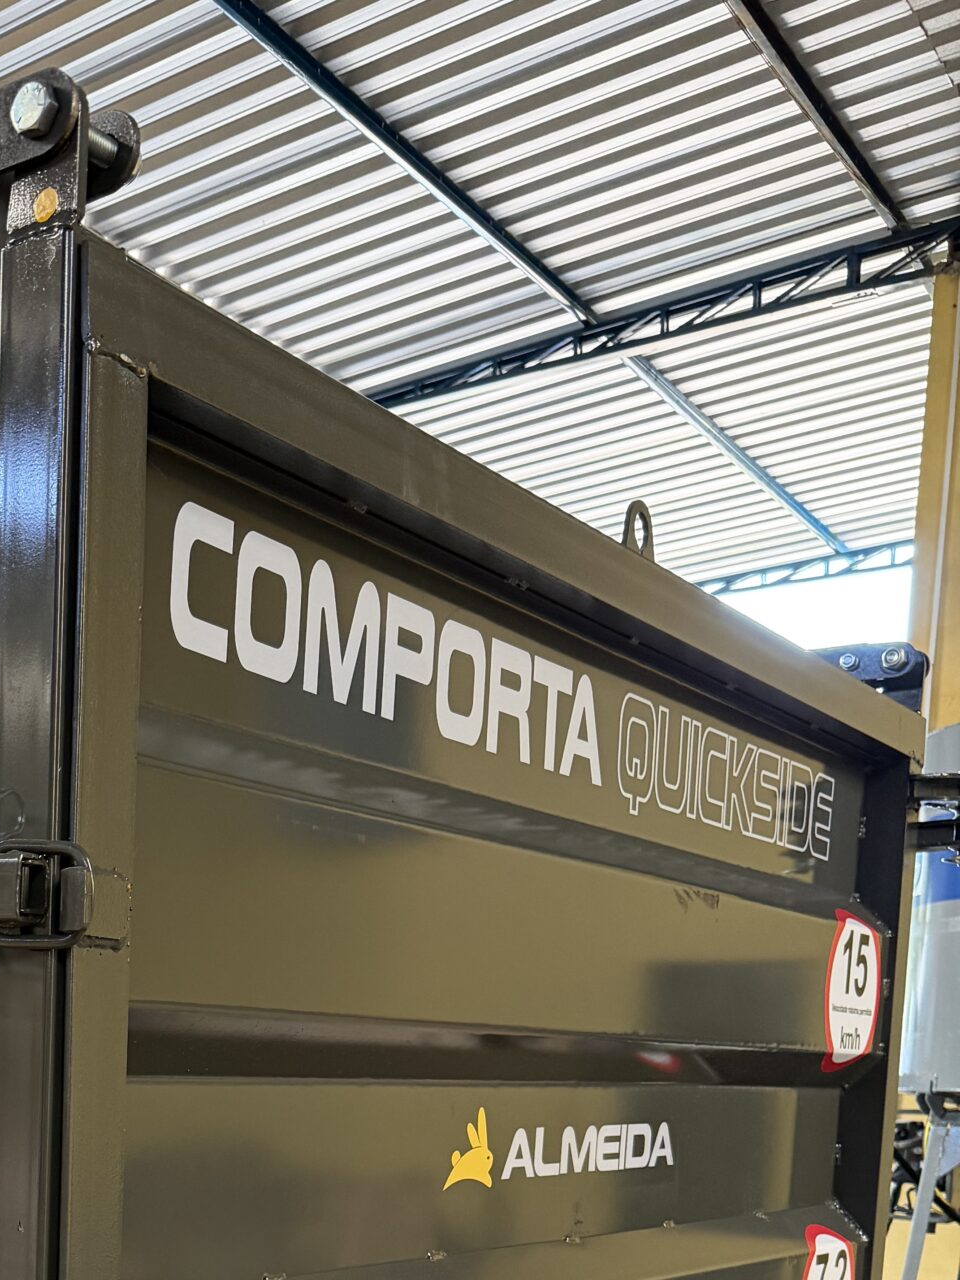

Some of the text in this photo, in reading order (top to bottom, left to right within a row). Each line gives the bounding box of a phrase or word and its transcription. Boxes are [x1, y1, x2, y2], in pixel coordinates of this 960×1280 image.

[170, 502, 835, 861] COMPORTA QUICKSIDE
[843, 930, 870, 997] 15
[840, 1026, 861, 1051] km/h
[500, 1121, 674, 1180] ALMEIDA
